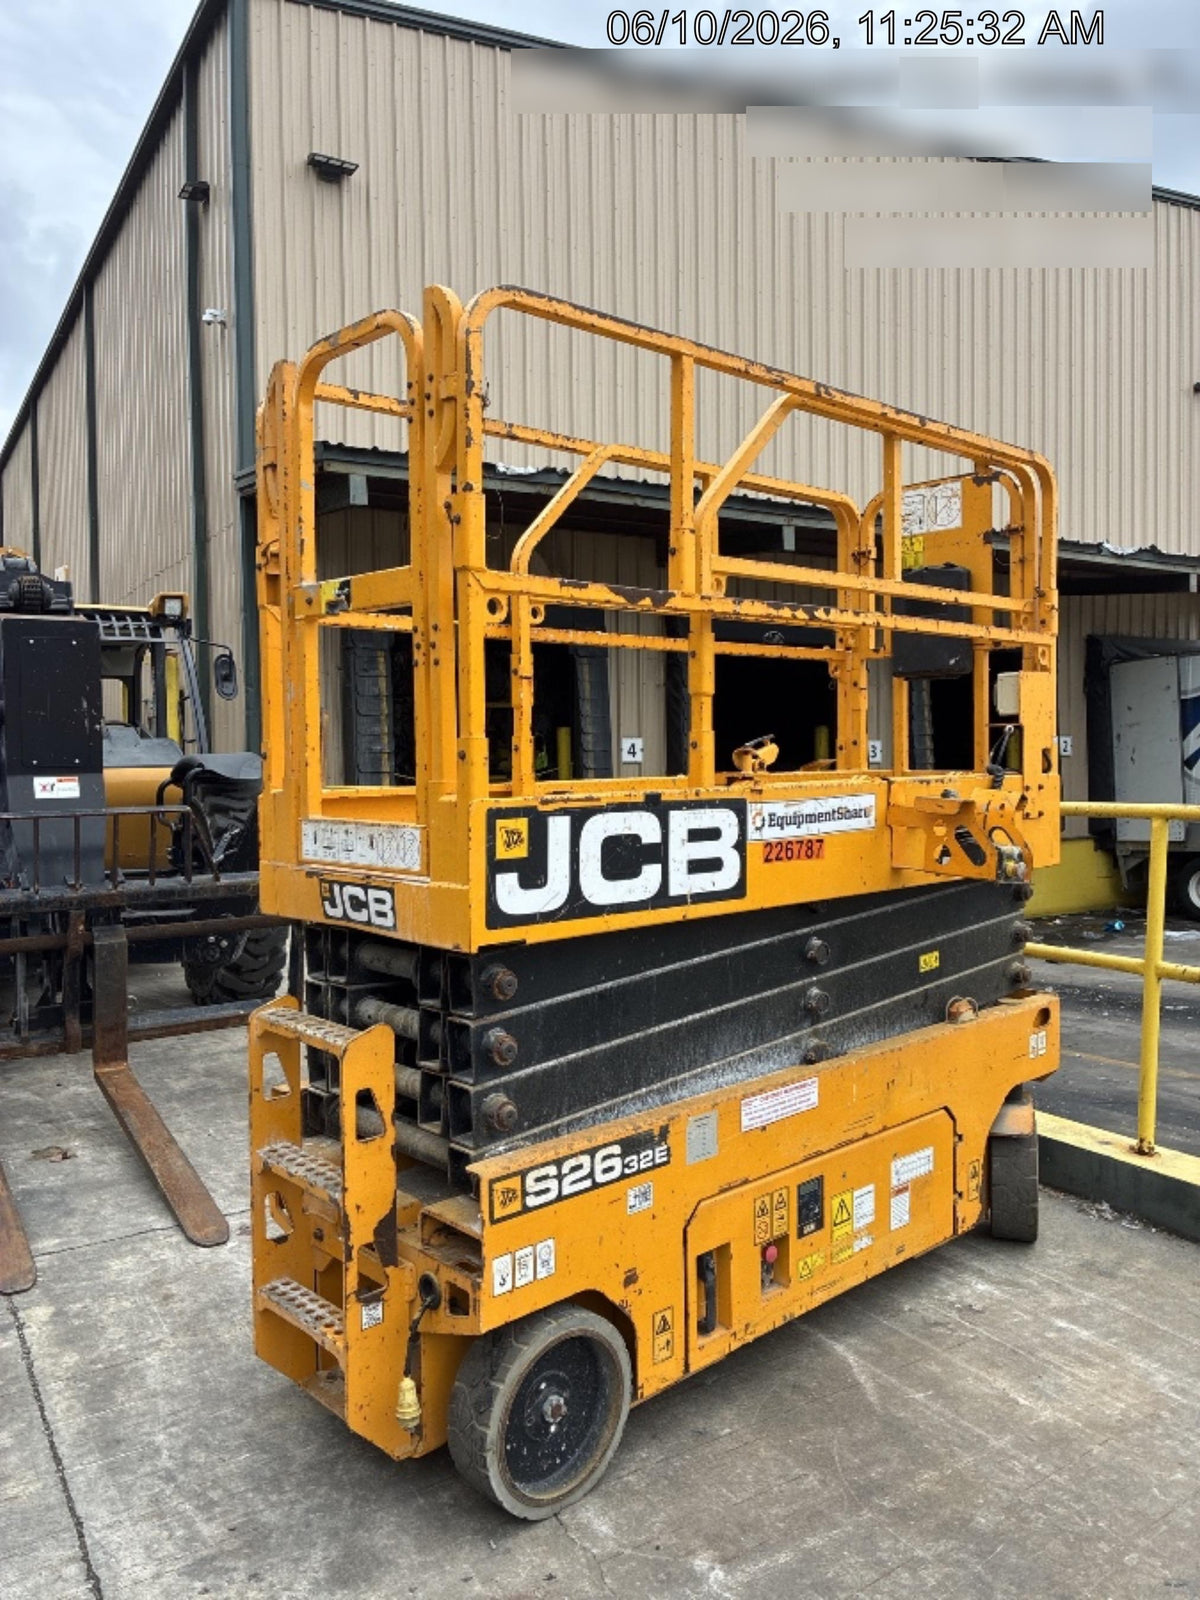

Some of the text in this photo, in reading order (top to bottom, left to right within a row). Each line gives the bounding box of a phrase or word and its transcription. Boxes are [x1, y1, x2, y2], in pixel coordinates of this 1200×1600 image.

[627, 743, 637, 758] 4
[495, 808, 742, 915] JCB
[763, 839, 824, 863] 226787
[323, 882, 395, 928] JCB
